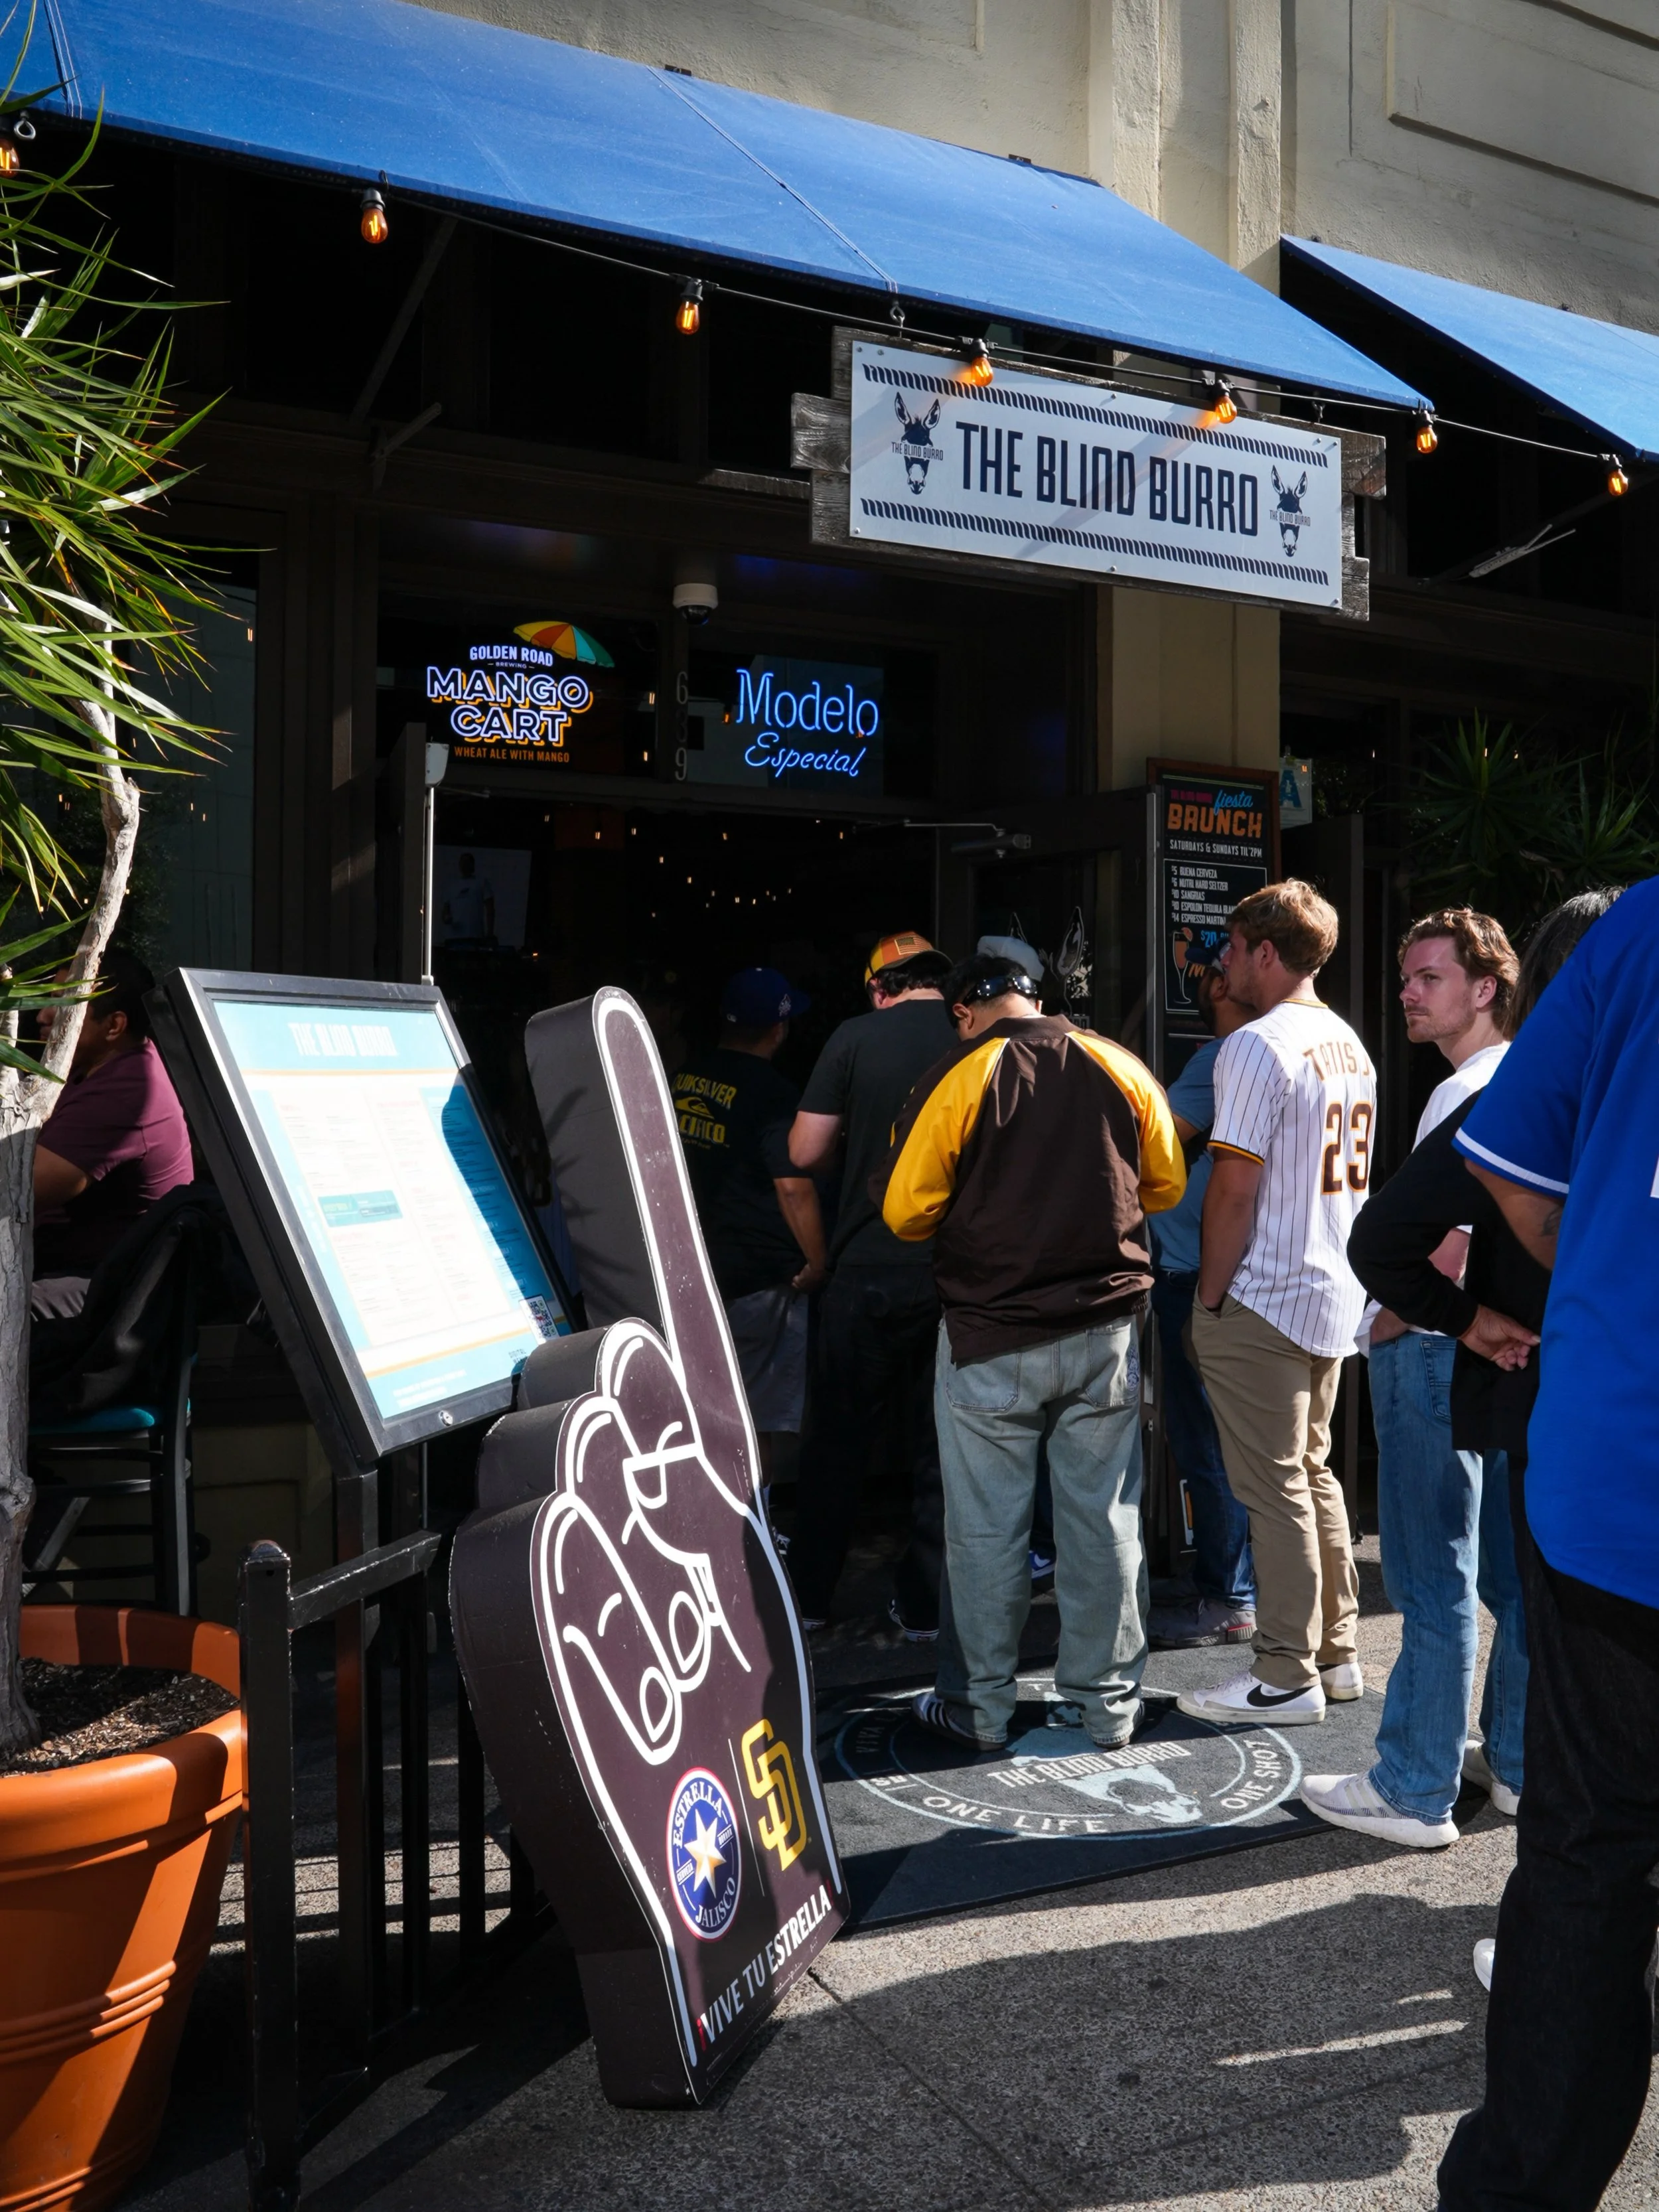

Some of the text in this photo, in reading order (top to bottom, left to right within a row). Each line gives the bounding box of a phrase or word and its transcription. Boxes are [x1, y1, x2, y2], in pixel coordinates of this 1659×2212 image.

[891, 441, 944, 461] THE BLIND BURRO
[956, 421, 1259, 536] THE BLIND BURRO
[1269, 509, 1311, 526] THE BLIND BURRO
[469, 645, 553, 666] GOLDEN ROAD
[427, 666, 592, 711] MANGO
[736, 668, 879, 737] Modelo
[450, 704, 569, 744] CART
[454, 746, 570, 763] WHEAT ALE WITH MANGO
[744, 731, 867, 777] Especial
[1213, 788, 1254, 816] fiesta
[1279, 769, 1302, 808] A
[1167, 802, 1263, 840] BRUNCH
[1169, 840, 1204, 852] SATURDAYS
[1205, 842, 1211, 853] &
[1212, 844, 1239, 855] SUNDAYS
[1180, 866, 1195, 877] BUENA
[1196, 868, 1217, 879] CERVEZA
[1195, 879, 1208, 889] HARD
[1208, 881, 1228, 891] SELTZER
[1181, 890, 1205, 901] SANGRIAS
[1181, 902, 1202, 912] ESPOLON
[1203, 903, 1222, 913] TEQUILA
[1181, 913, 1206, 924] ESPRESSO
[1301, 1041, 1358, 1081] TATIS
[1321, 1100, 1372, 1195] 23
[987, 1741, 1191, 1788] THE BLIND BURRO
[1243, 1739, 1283, 1779] SHOT
[741, 1719, 807, 1871] SD
[1220, 1781, 1274, 1810] ONE
[672, 1781, 723, 1849] ESTRELLA
[923, 1796, 1109, 1834] ONE LIFE
[695, 1877, 736, 1929] JALISCO
[742, 1956, 766, 2000] TU
